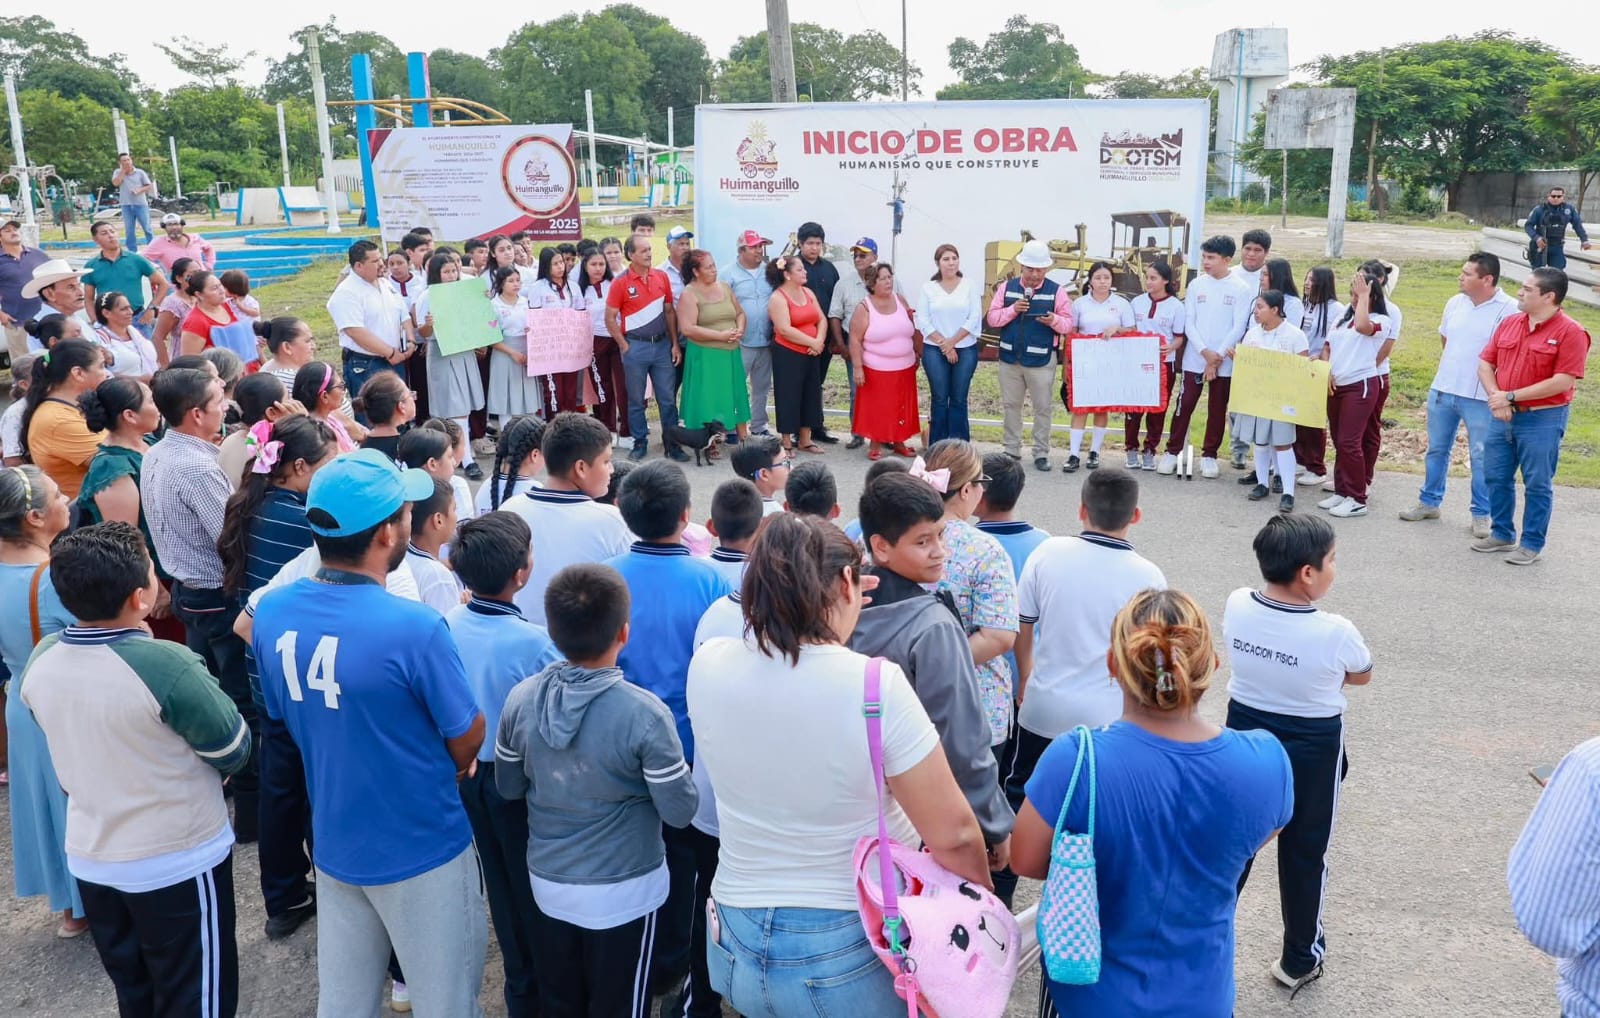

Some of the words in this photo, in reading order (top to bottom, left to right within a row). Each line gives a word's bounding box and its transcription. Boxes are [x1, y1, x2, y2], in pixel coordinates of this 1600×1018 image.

[803, 130, 905, 155] INICIO
[916, 129, 963, 154] DE
[974, 126, 1078, 153] OBRA
[838, 159, 921, 171] HUMANISMO
[925, 159, 953, 170] QUE
[956, 158, 1040, 170] CONSTRUYE
[1100, 148, 1181, 166] DOOTSM
[515, 184, 565, 195] Huimanguillo
[720, 177, 800, 193] Huimanguillo
[548, 218, 579, 230] 2025
[1233, 638, 1272, 660] EDUCACION
[1275, 651, 1298, 667] FISICA
[275, 630, 342, 710] 14
